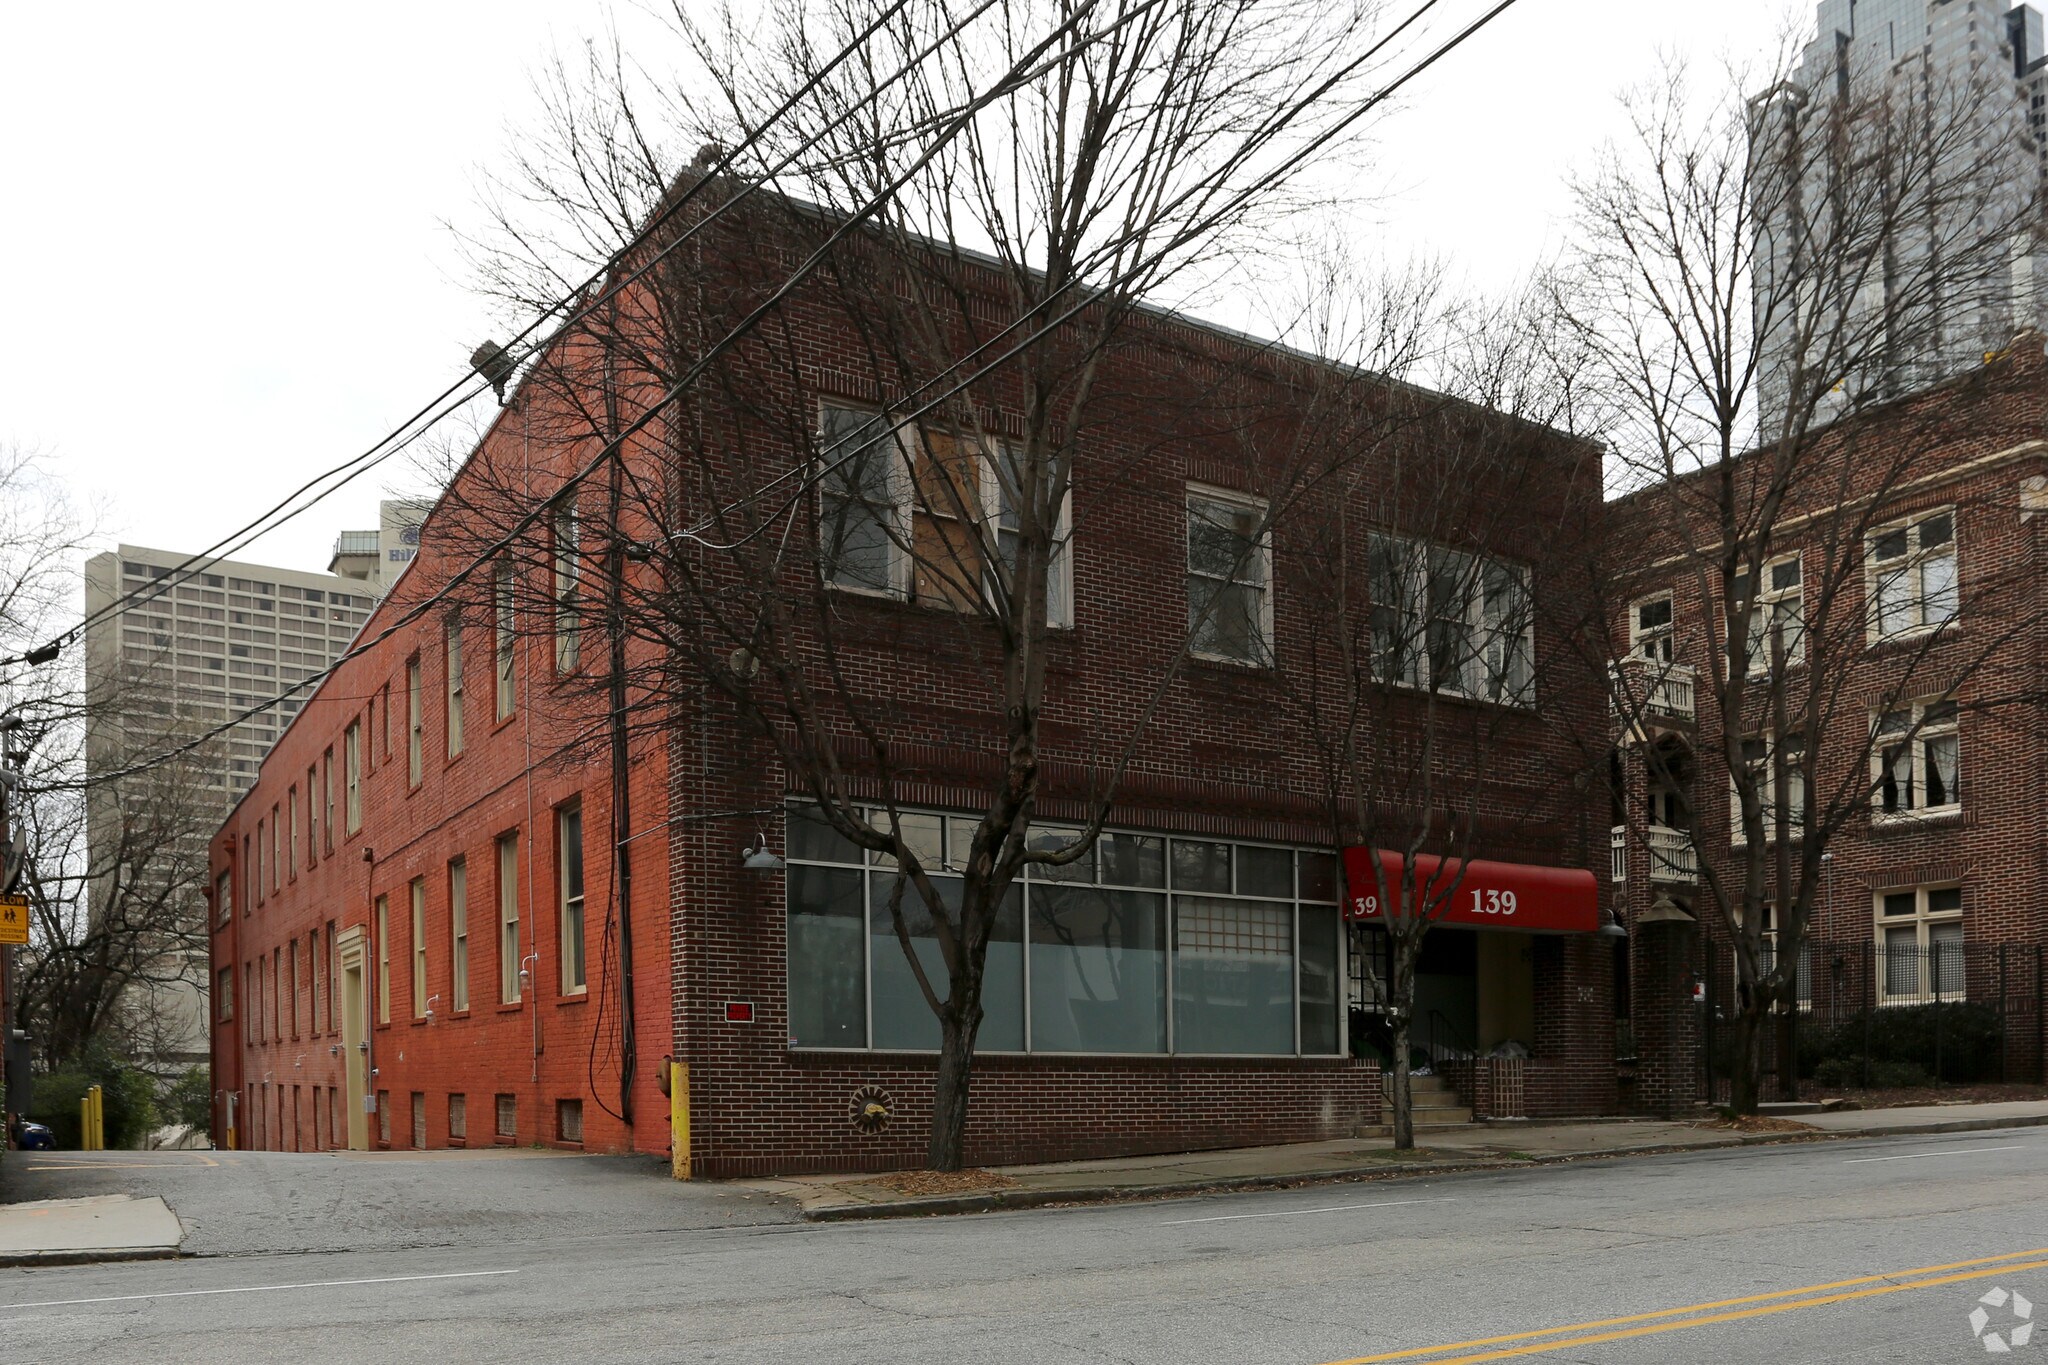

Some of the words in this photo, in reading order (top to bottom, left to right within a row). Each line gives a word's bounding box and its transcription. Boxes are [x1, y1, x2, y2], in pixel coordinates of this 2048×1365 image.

[0, 896, 24, 905] LOW
[1345, 896, 1377, 917] 39
[1470, 888, 1517, 915] 139
